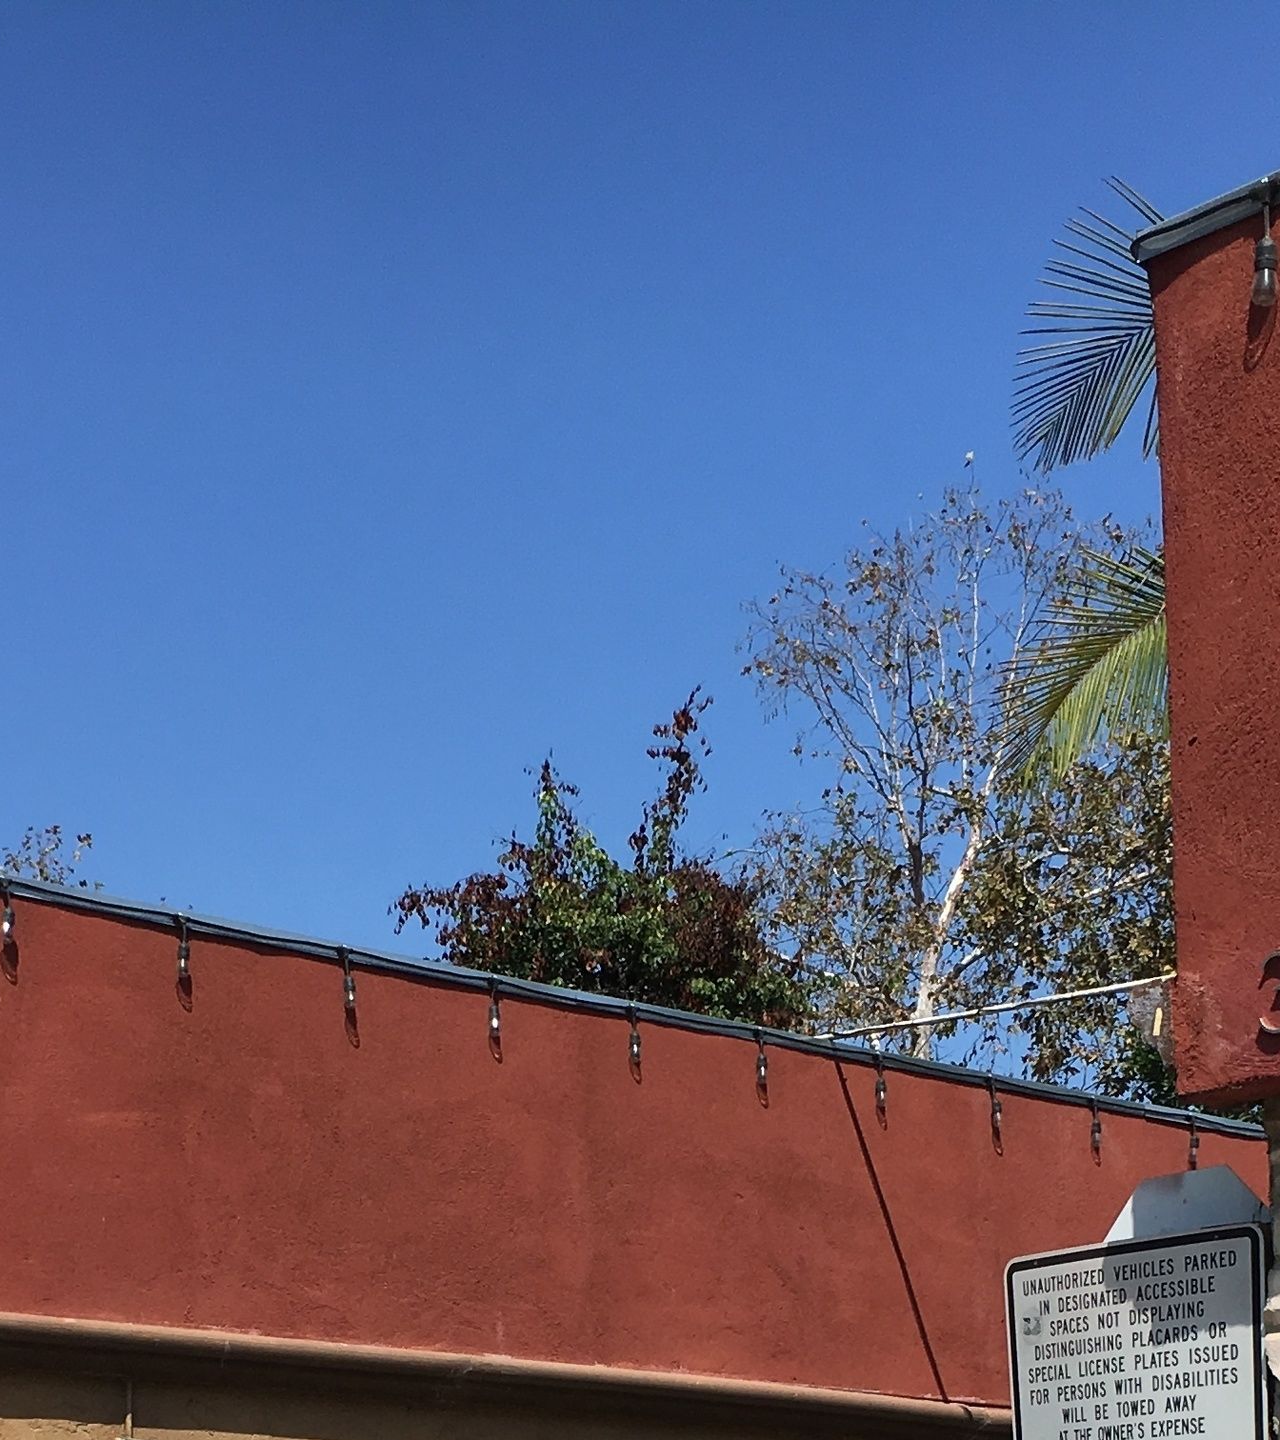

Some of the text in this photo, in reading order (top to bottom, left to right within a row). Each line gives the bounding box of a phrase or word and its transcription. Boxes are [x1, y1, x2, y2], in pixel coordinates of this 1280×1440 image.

[1022, 1250, 1237, 1297] UNAUTHORIZED VEHICLES PARKED
[1039, 1276, 1216, 1316] IN DESIGNATED ACCESSIBLE
[1050, 1300, 1205, 1337] SPACES NOT DISPLAYING
[1034, 1321, 1227, 1361] DISTINGUISHING PLACARDS OR
[1028, 1344, 1239, 1384] SPECIAL LICENSE PLATES ISSUED
[1029, 1367, 1239, 1406] FOR PERSONS WITH DISABILITIES
[1062, 1394, 1197, 1424] WILL BE TOWED AWAY
[1151, 1416, 1206, 1438] EXPENSE
